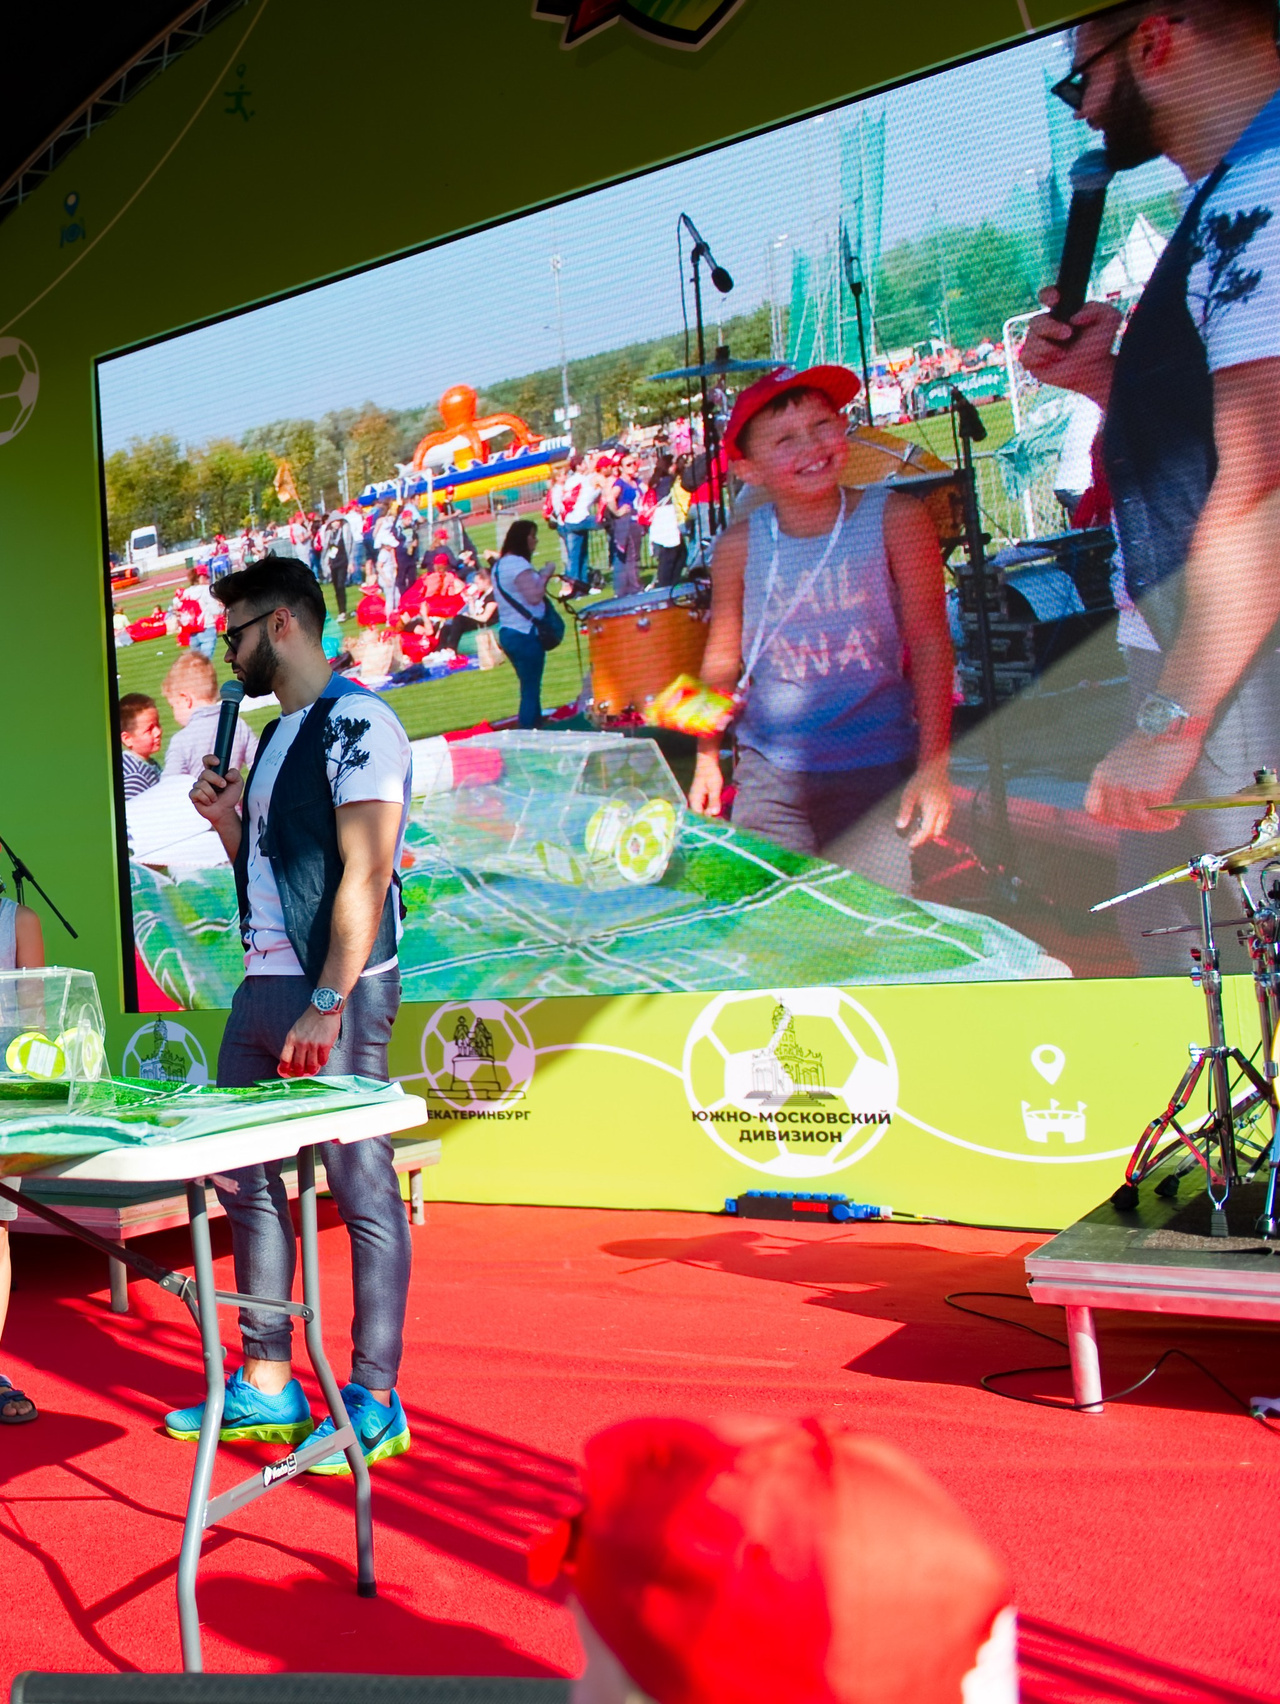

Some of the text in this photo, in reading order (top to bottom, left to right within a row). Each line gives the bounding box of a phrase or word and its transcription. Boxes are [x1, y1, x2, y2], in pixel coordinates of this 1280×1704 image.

[427, 1109, 531, 1121] ЕКАТЕРИНБУРГ
[692, 1109, 892, 1125] ЮЖНО-МОСКОВСКИЙ
[738, 1129, 843, 1143] ДИВИЗИОН
